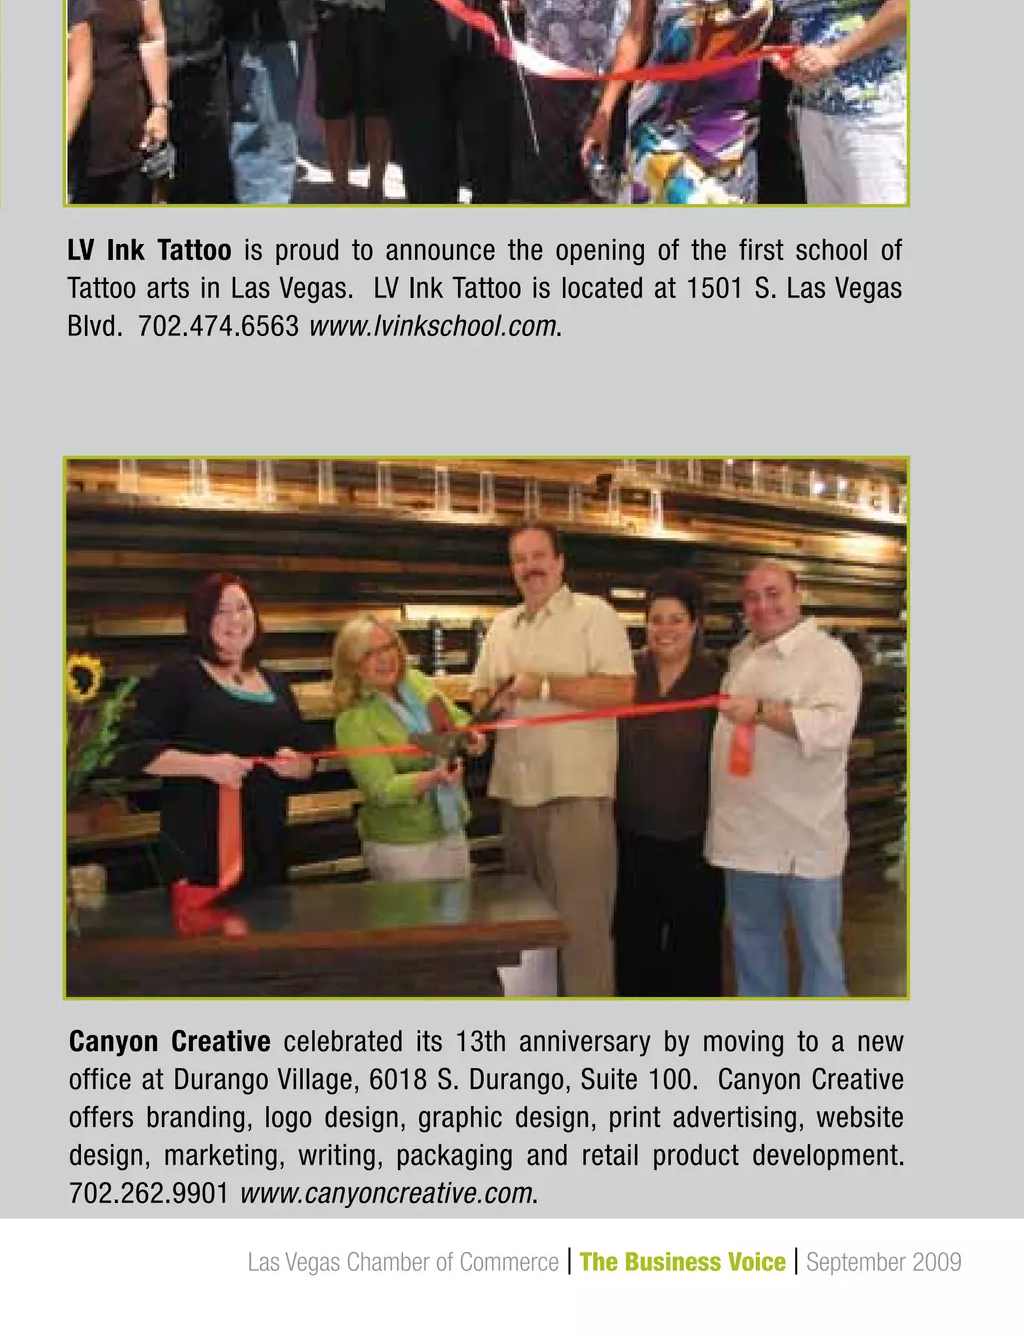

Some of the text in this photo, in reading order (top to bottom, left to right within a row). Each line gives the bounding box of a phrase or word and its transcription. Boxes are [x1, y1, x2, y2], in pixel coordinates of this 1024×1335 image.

[68, 238, 902, 265] LV Ink Tattoo is proud to announce the opening of the first school of
[69, 314, 561, 336] Blvd. 702.474.6563 www.lvinkschool.com.
[70, 1030, 904, 1057] Canyon Creative celebrated its 13th anniversary by moving to a new
[70, 1182, 537, 1208] 702.262.9901 www.canyoncreative.com.
[249, 1252, 558, 1275] Las Vegas Chamber of Commerce
[580, 1252, 786, 1272] The Business Voice
[807, 1252, 961, 1275] September 2009
